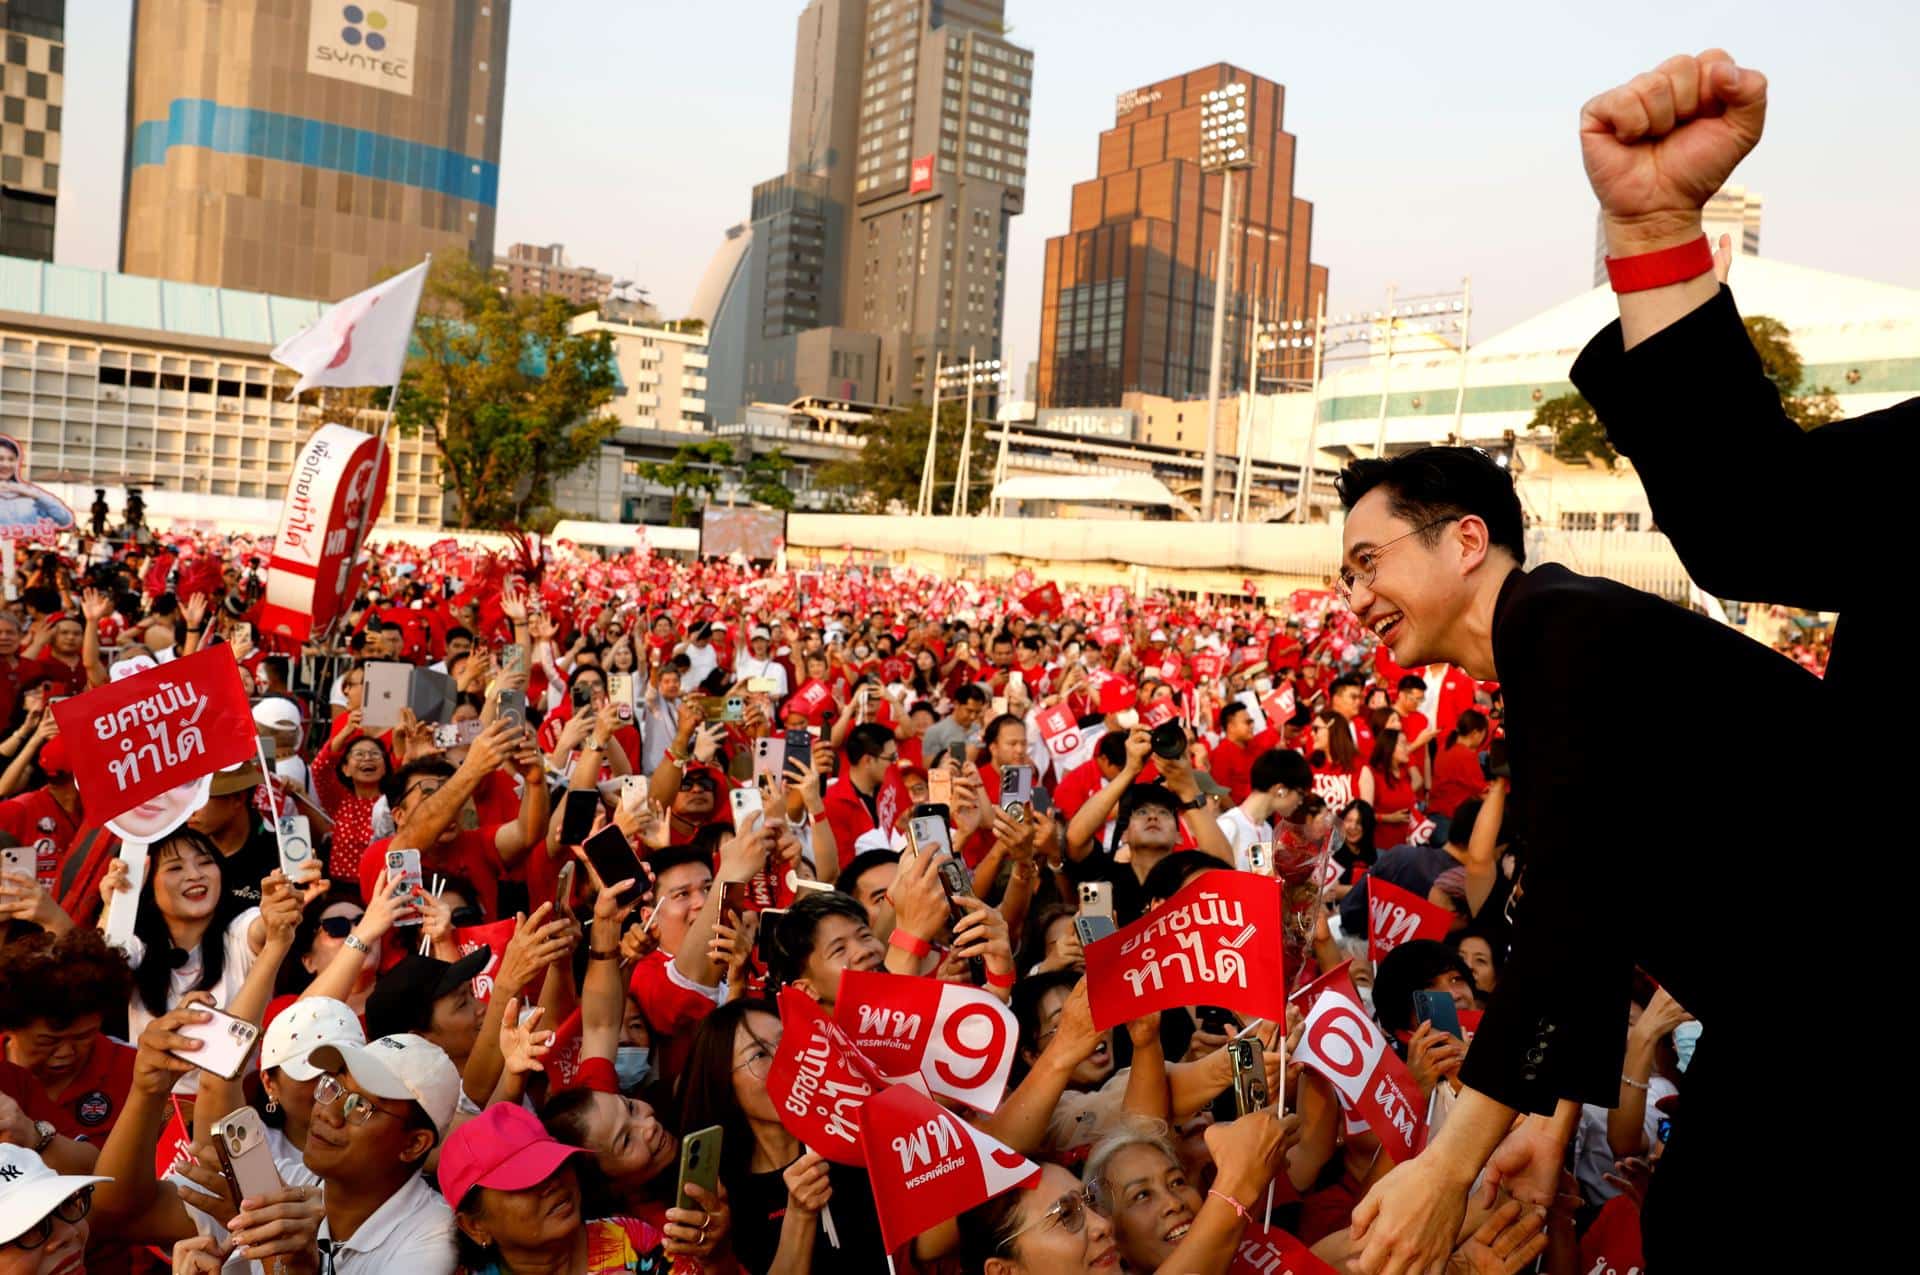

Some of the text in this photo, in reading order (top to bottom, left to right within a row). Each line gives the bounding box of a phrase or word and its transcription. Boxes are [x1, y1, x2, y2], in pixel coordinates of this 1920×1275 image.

[315, 46, 408, 79] SYNTEC
[94, 681, 198, 740] ยศชนัน
[108, 695, 208, 791] ทำได้
[1120, 892, 1244, 955] ยศชนัน
[1123, 923, 1257, 997] ทำได้
[858, 1004, 921, 1040] พท
[935, 1003, 1007, 1089] 9
[1308, 1007, 1373, 1077] 9
[891, 1114, 963, 1173] พท
[1374, 1080, 1413, 1147] พท
[905, 1156, 966, 1189] พรรคเพื่อไทย
